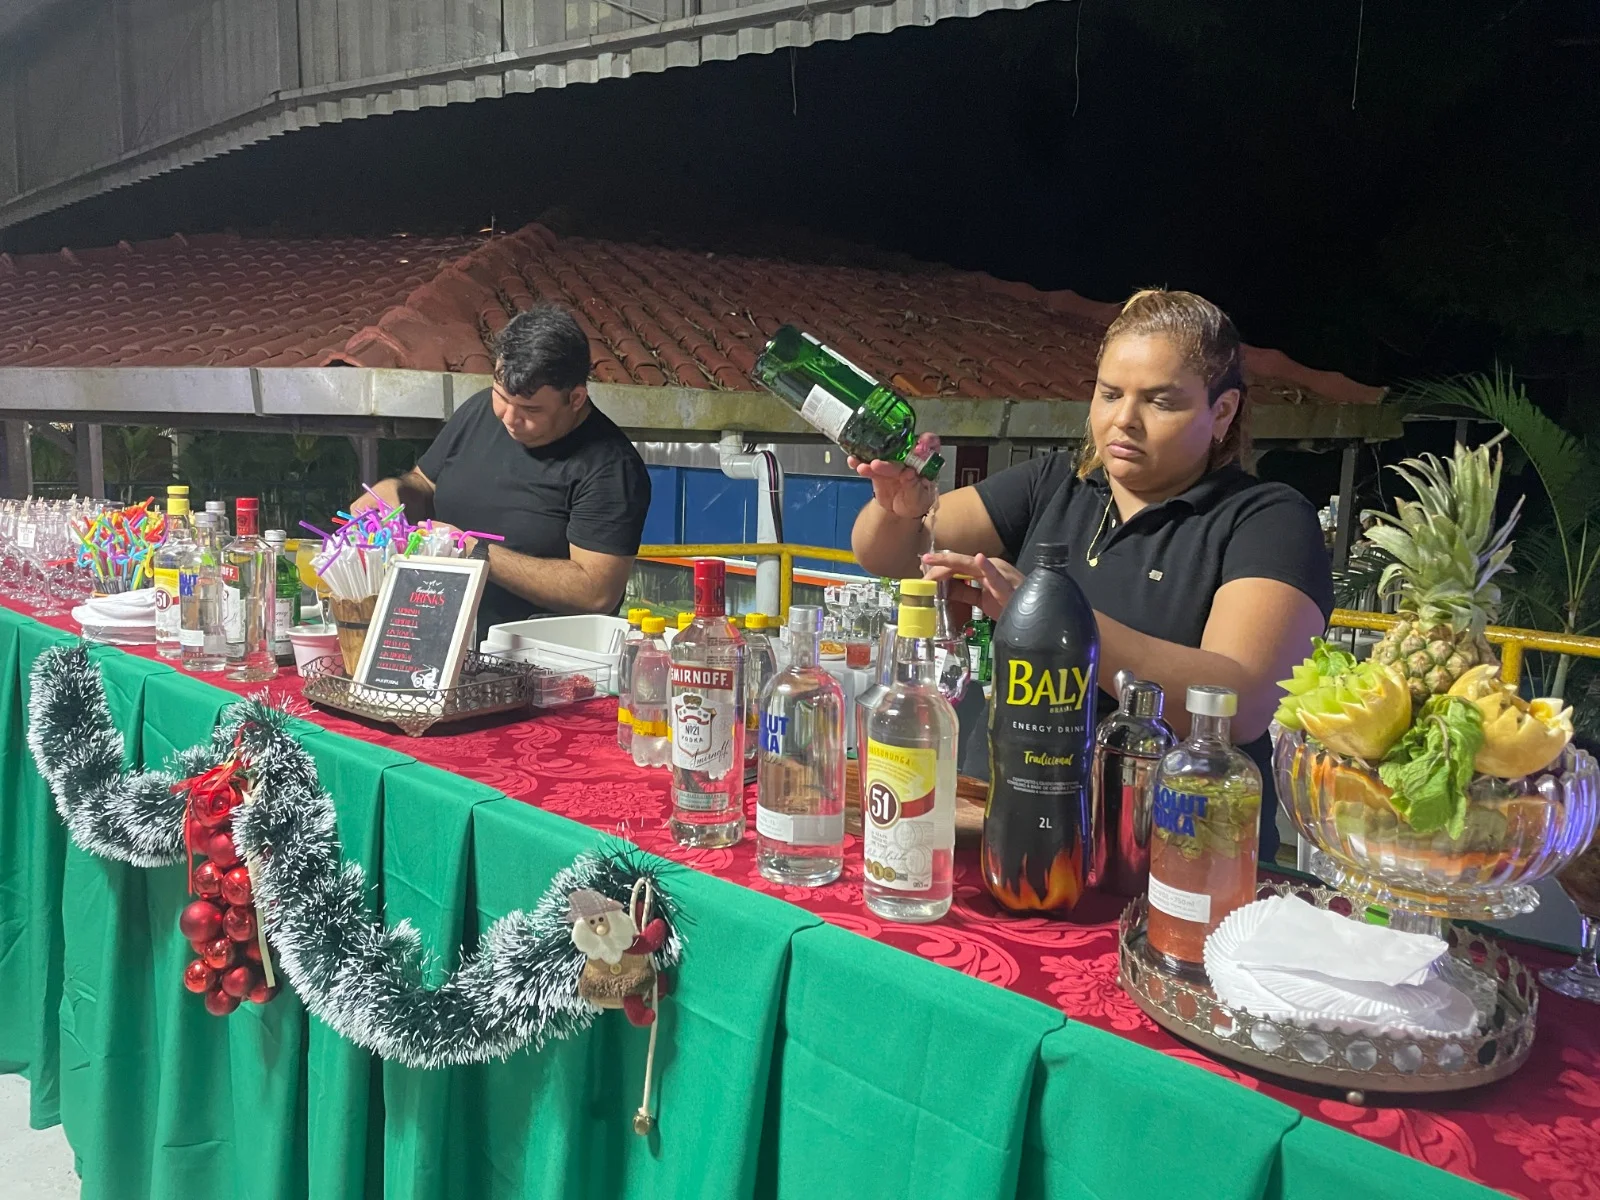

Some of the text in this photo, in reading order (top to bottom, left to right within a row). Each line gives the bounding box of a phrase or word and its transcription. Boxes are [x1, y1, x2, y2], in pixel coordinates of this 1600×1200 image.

[156, 593, 166, 607] 51
[1006, 660, 1094, 710] BALY
[1012, 721, 1052, 733] ENERGY
[681, 735, 704, 743] VODKA
[1023, 750, 1075, 766] Tradicional
[871, 788, 890, 820] 51
[1039, 816, 1053, 829] 2L
